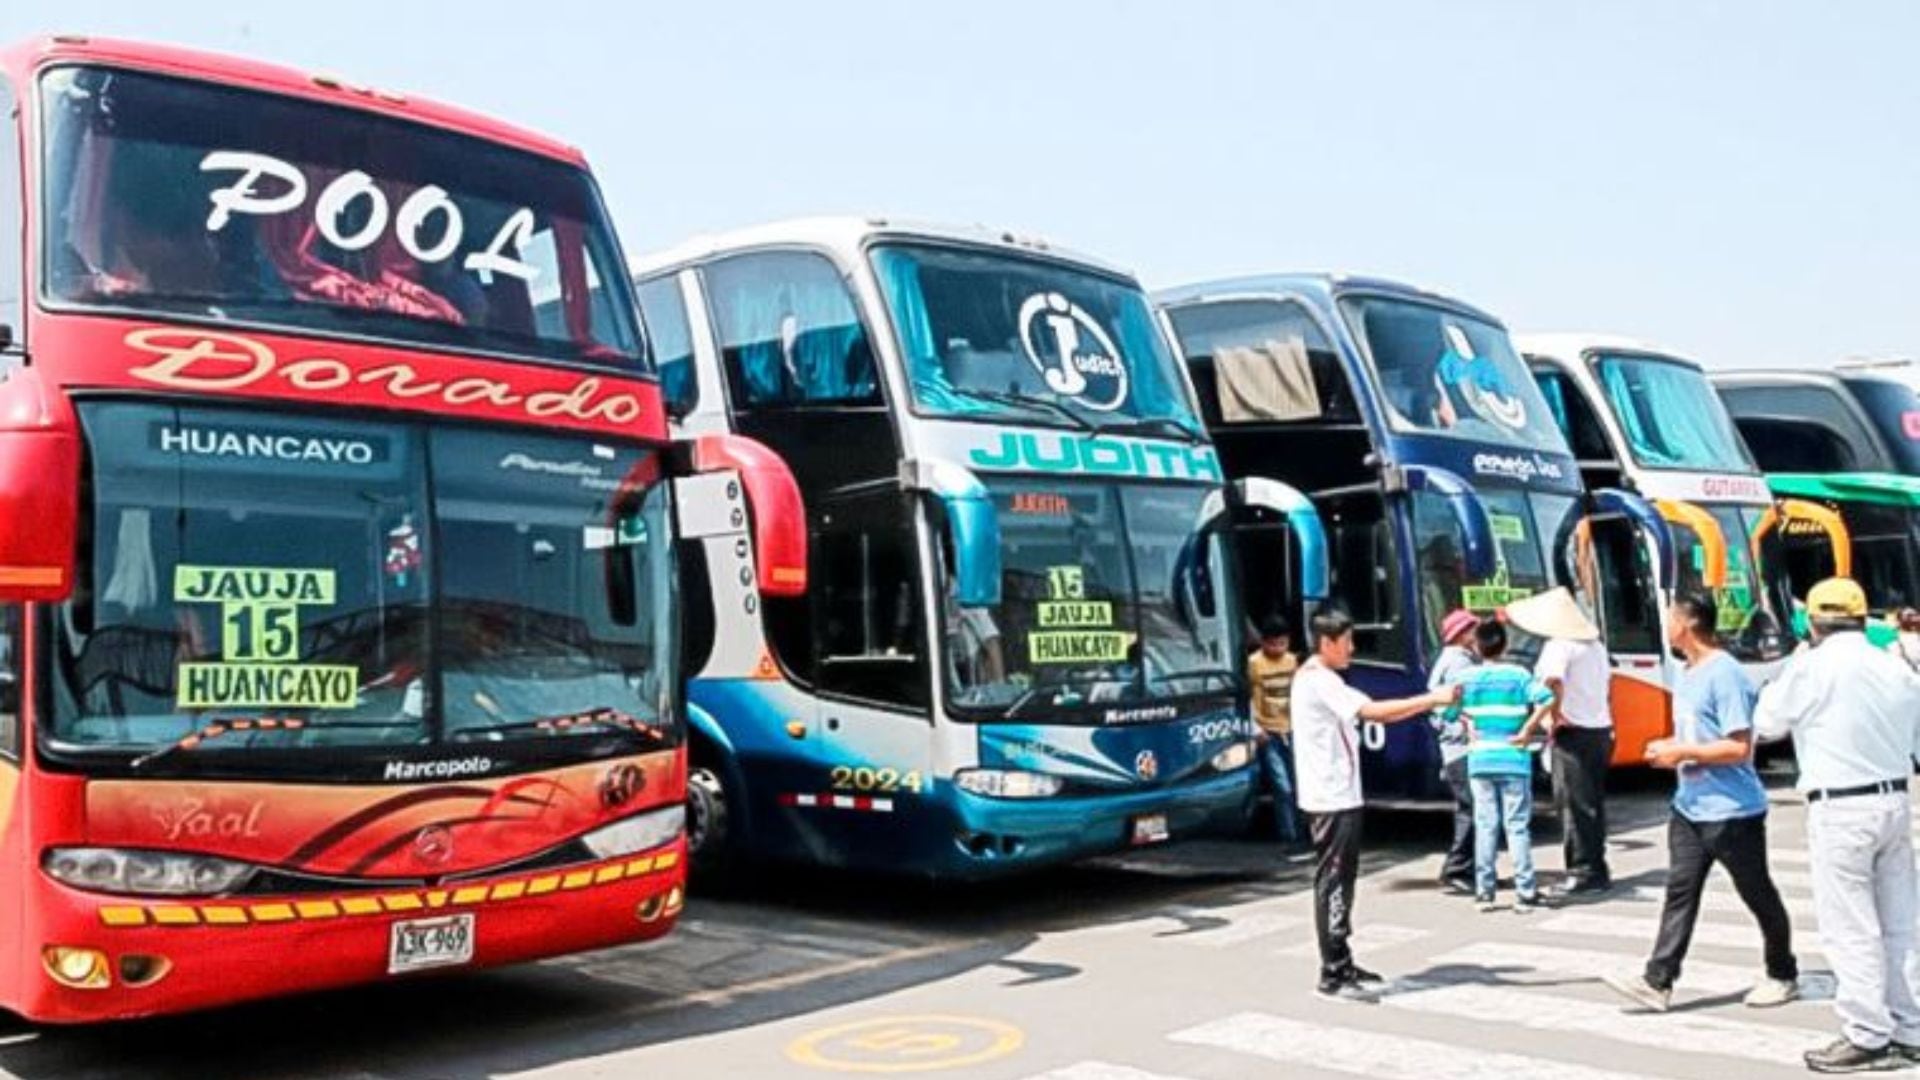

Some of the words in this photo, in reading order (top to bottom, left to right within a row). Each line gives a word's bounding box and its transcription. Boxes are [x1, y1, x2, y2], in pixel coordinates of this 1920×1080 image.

[200, 151, 540, 284] POOL
[124, 328, 640, 424] Dorado
[160, 428, 373, 464] HUANCAYO
[969, 432, 1223, 484] JUDITH
[184, 570, 324, 600] JAUJA
[1055, 567, 1084, 599] 15
[227, 605, 293, 658] 15
[1043, 605, 1108, 624] JAUJA
[1037, 635, 1123, 660] HUANCAYO
[188, 667, 352, 703] HUANCAYO
[384, 756, 492, 780] Marcopolo
[831, 765, 923, 794] 2024
